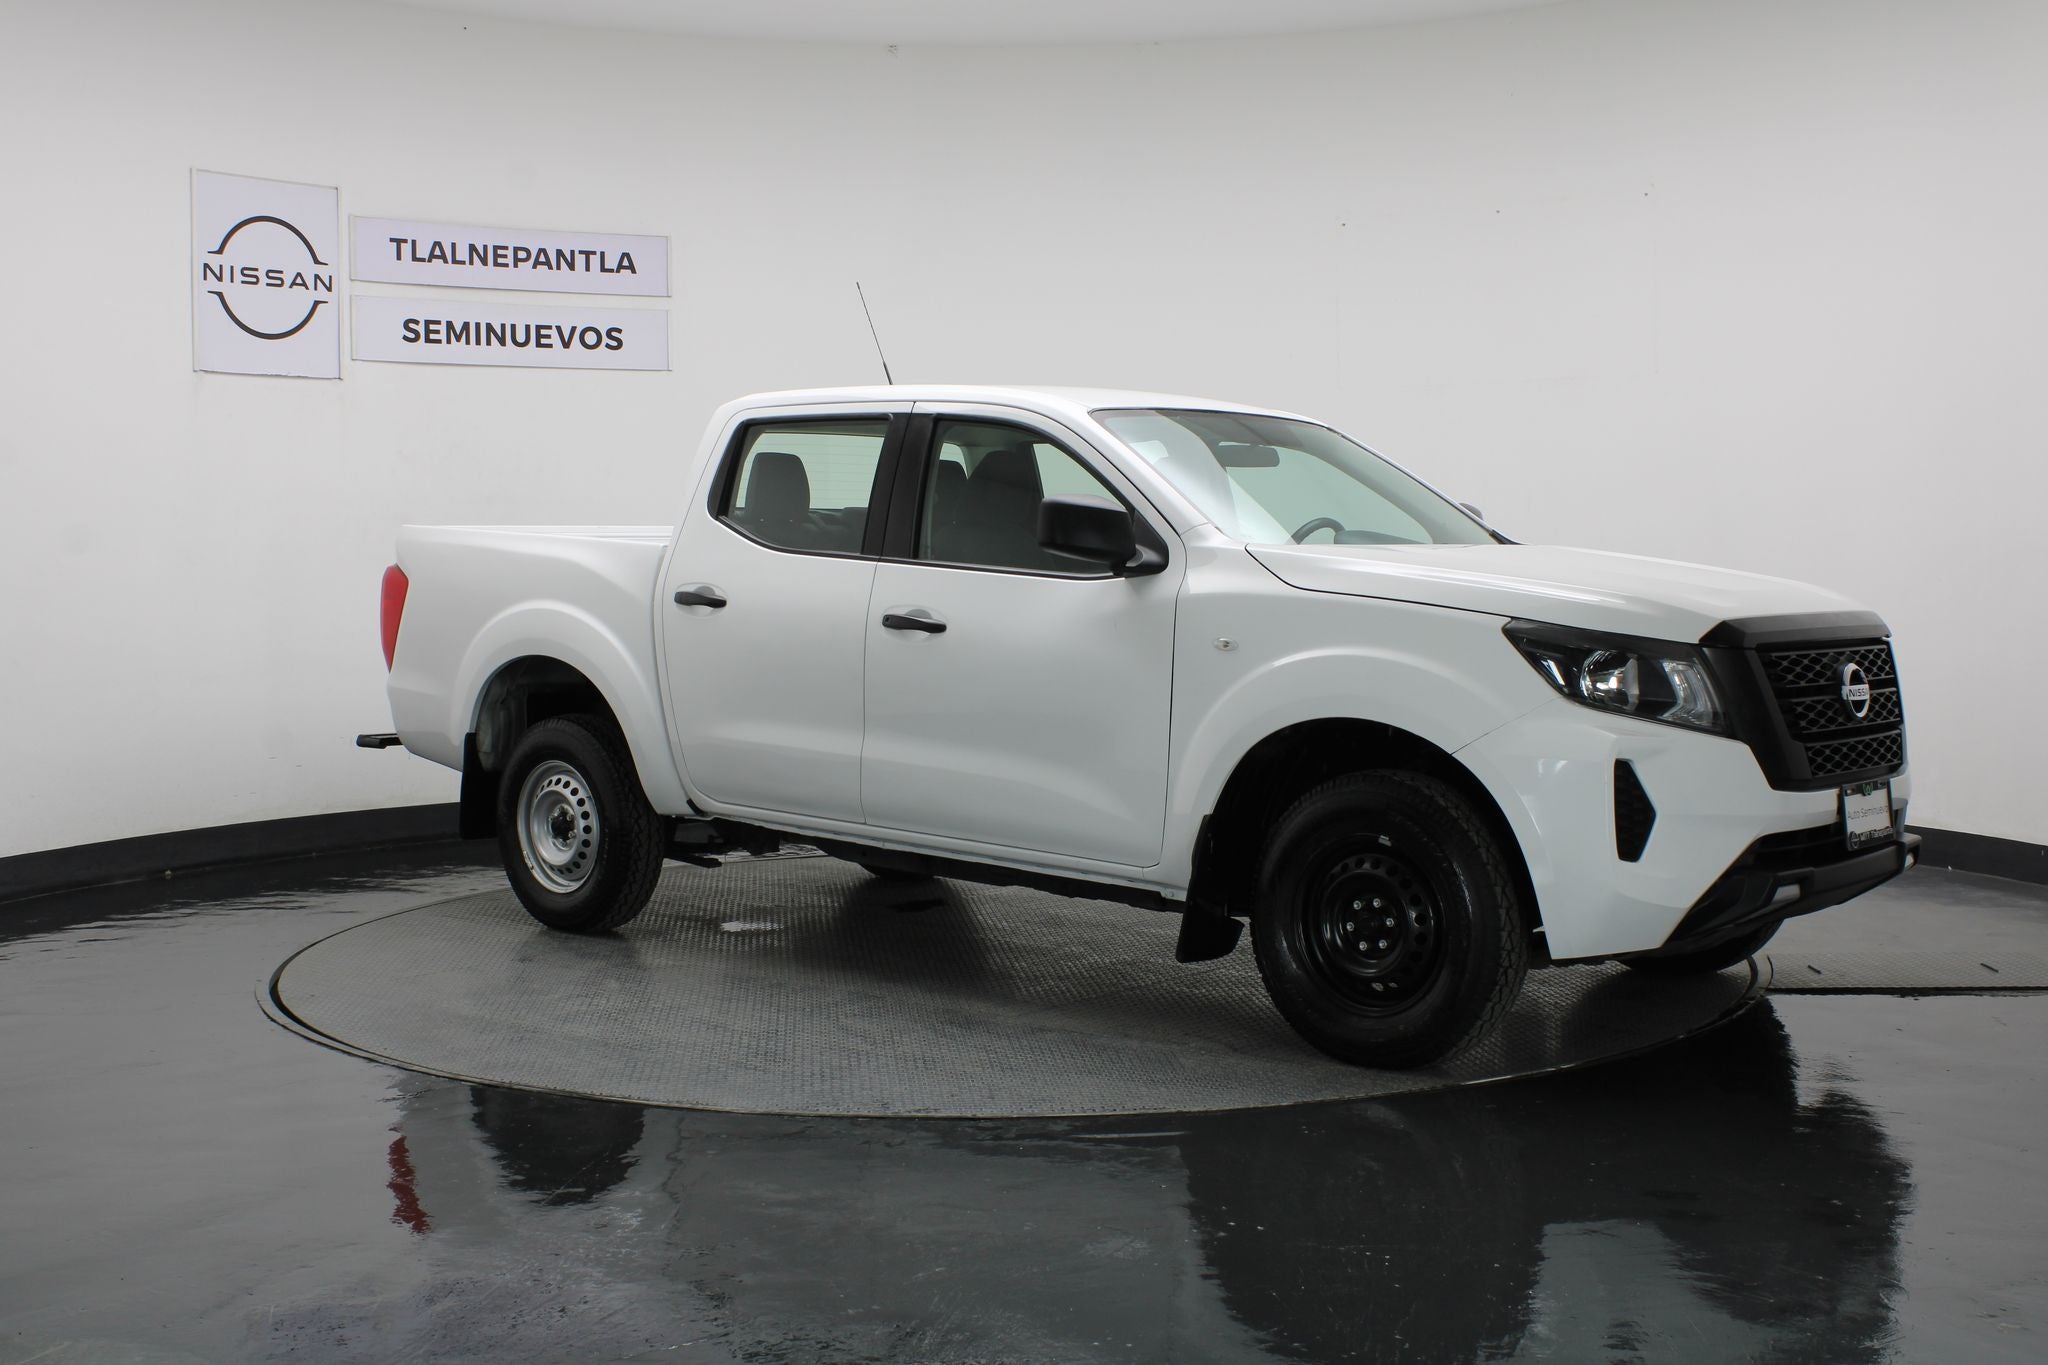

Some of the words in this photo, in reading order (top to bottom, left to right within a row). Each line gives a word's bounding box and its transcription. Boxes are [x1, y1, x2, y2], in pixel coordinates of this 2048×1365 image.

[389, 237, 637, 275] TLALNEPANTLA
[202, 262, 333, 293] NISSAN
[401, 318, 624, 351] SEMINUEVOS
[1848, 687, 1869, 699] NISS
